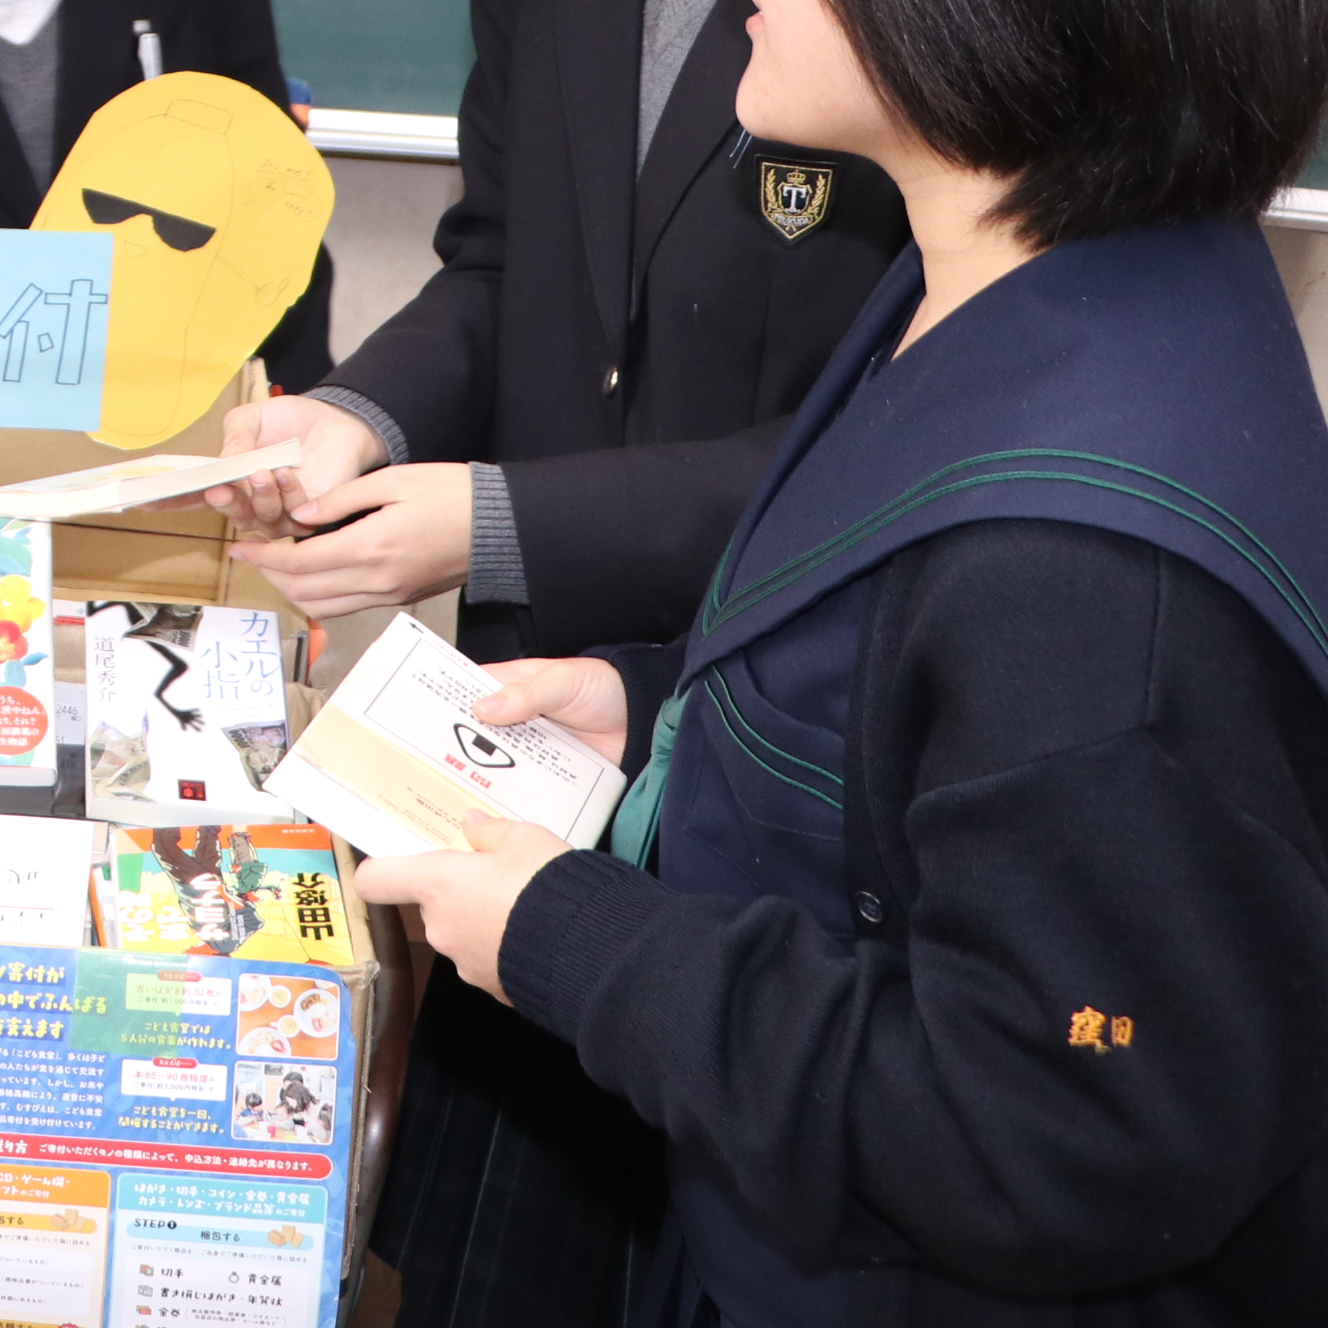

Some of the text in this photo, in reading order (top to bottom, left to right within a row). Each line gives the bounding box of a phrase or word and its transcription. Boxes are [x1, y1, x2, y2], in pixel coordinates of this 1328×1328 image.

[93, 636, 118, 704] 道尾秀介
[200, 641, 240, 701] 小指
[239, 611, 281, 697] カエルの
[188, 871, 231, 941] サヨナラ
[292, 871, 335, 941] 山田悠介
